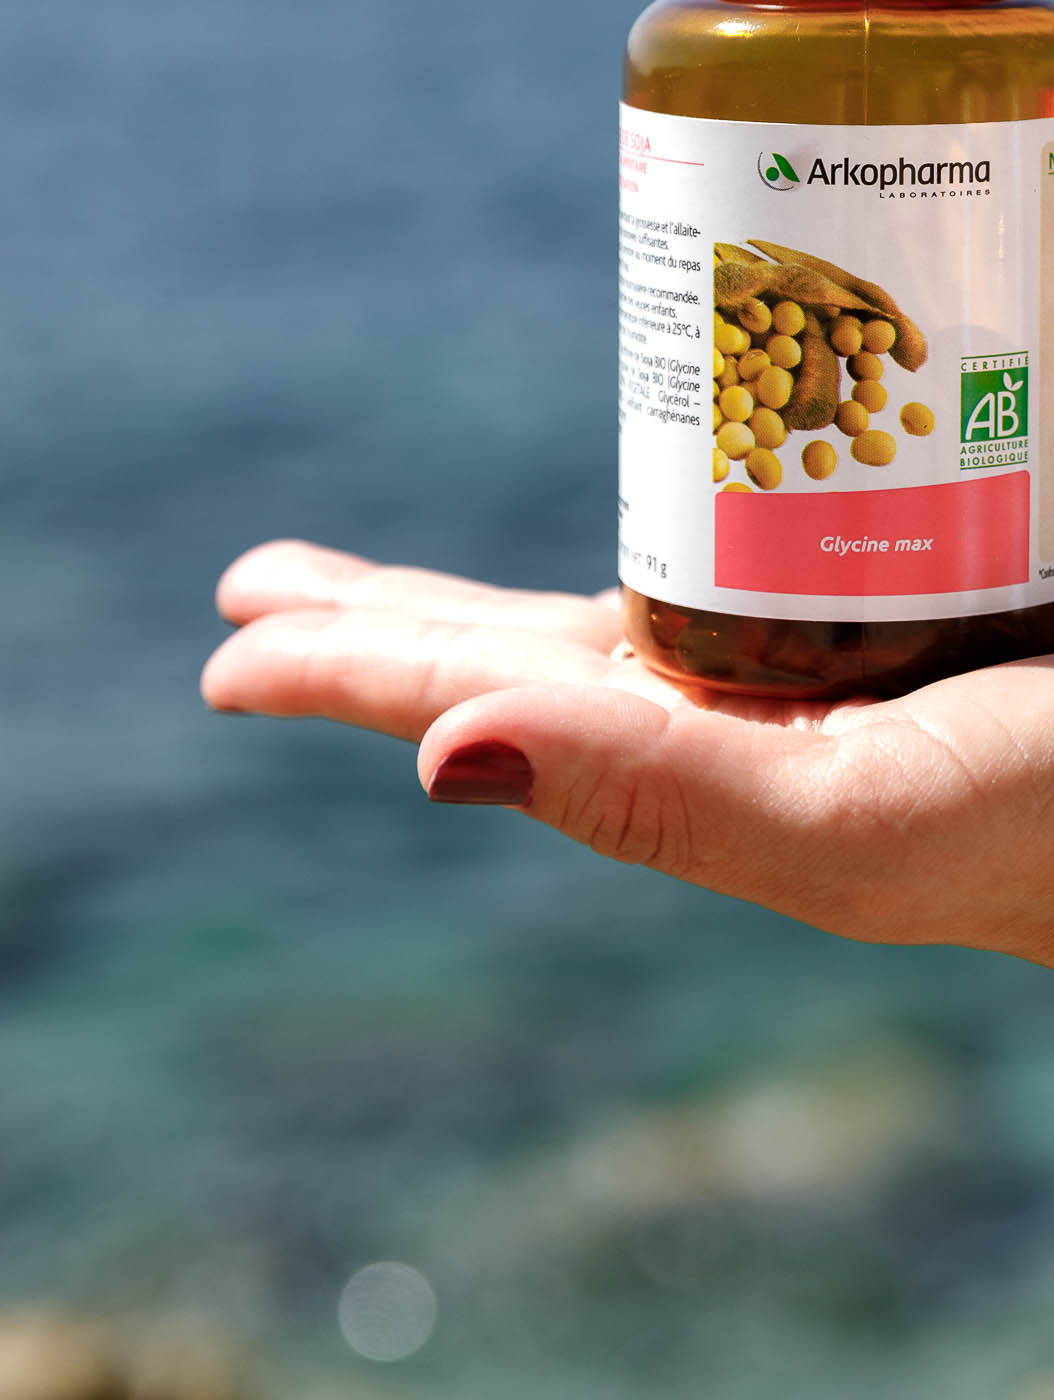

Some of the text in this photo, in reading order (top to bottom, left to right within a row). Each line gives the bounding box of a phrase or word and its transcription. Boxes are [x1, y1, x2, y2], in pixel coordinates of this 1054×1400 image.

[807, 157, 990, 191] Arkopharma
[879, 189, 991, 199] LABORATOIRES
[667, 253, 678, 269] du
[678, 259, 702, 274] repas
[695, 325, 701, 339] à
[667, 357, 701, 376] (Glycine
[960, 354, 1029, 372] CERTIFIÉ
[667, 375, 701, 393] (Glycine
[658, 390, 690, 411] Glycérol
[965, 391, 1019, 440] AB
[960, 439, 1029, 455] AGRICULTURE
[960, 451, 1029, 467] BIOLOGIQUE
[820, 536, 934, 556] Glycine max
[646, 555, 657, 572] 91
[660, 563, 667, 578] g
